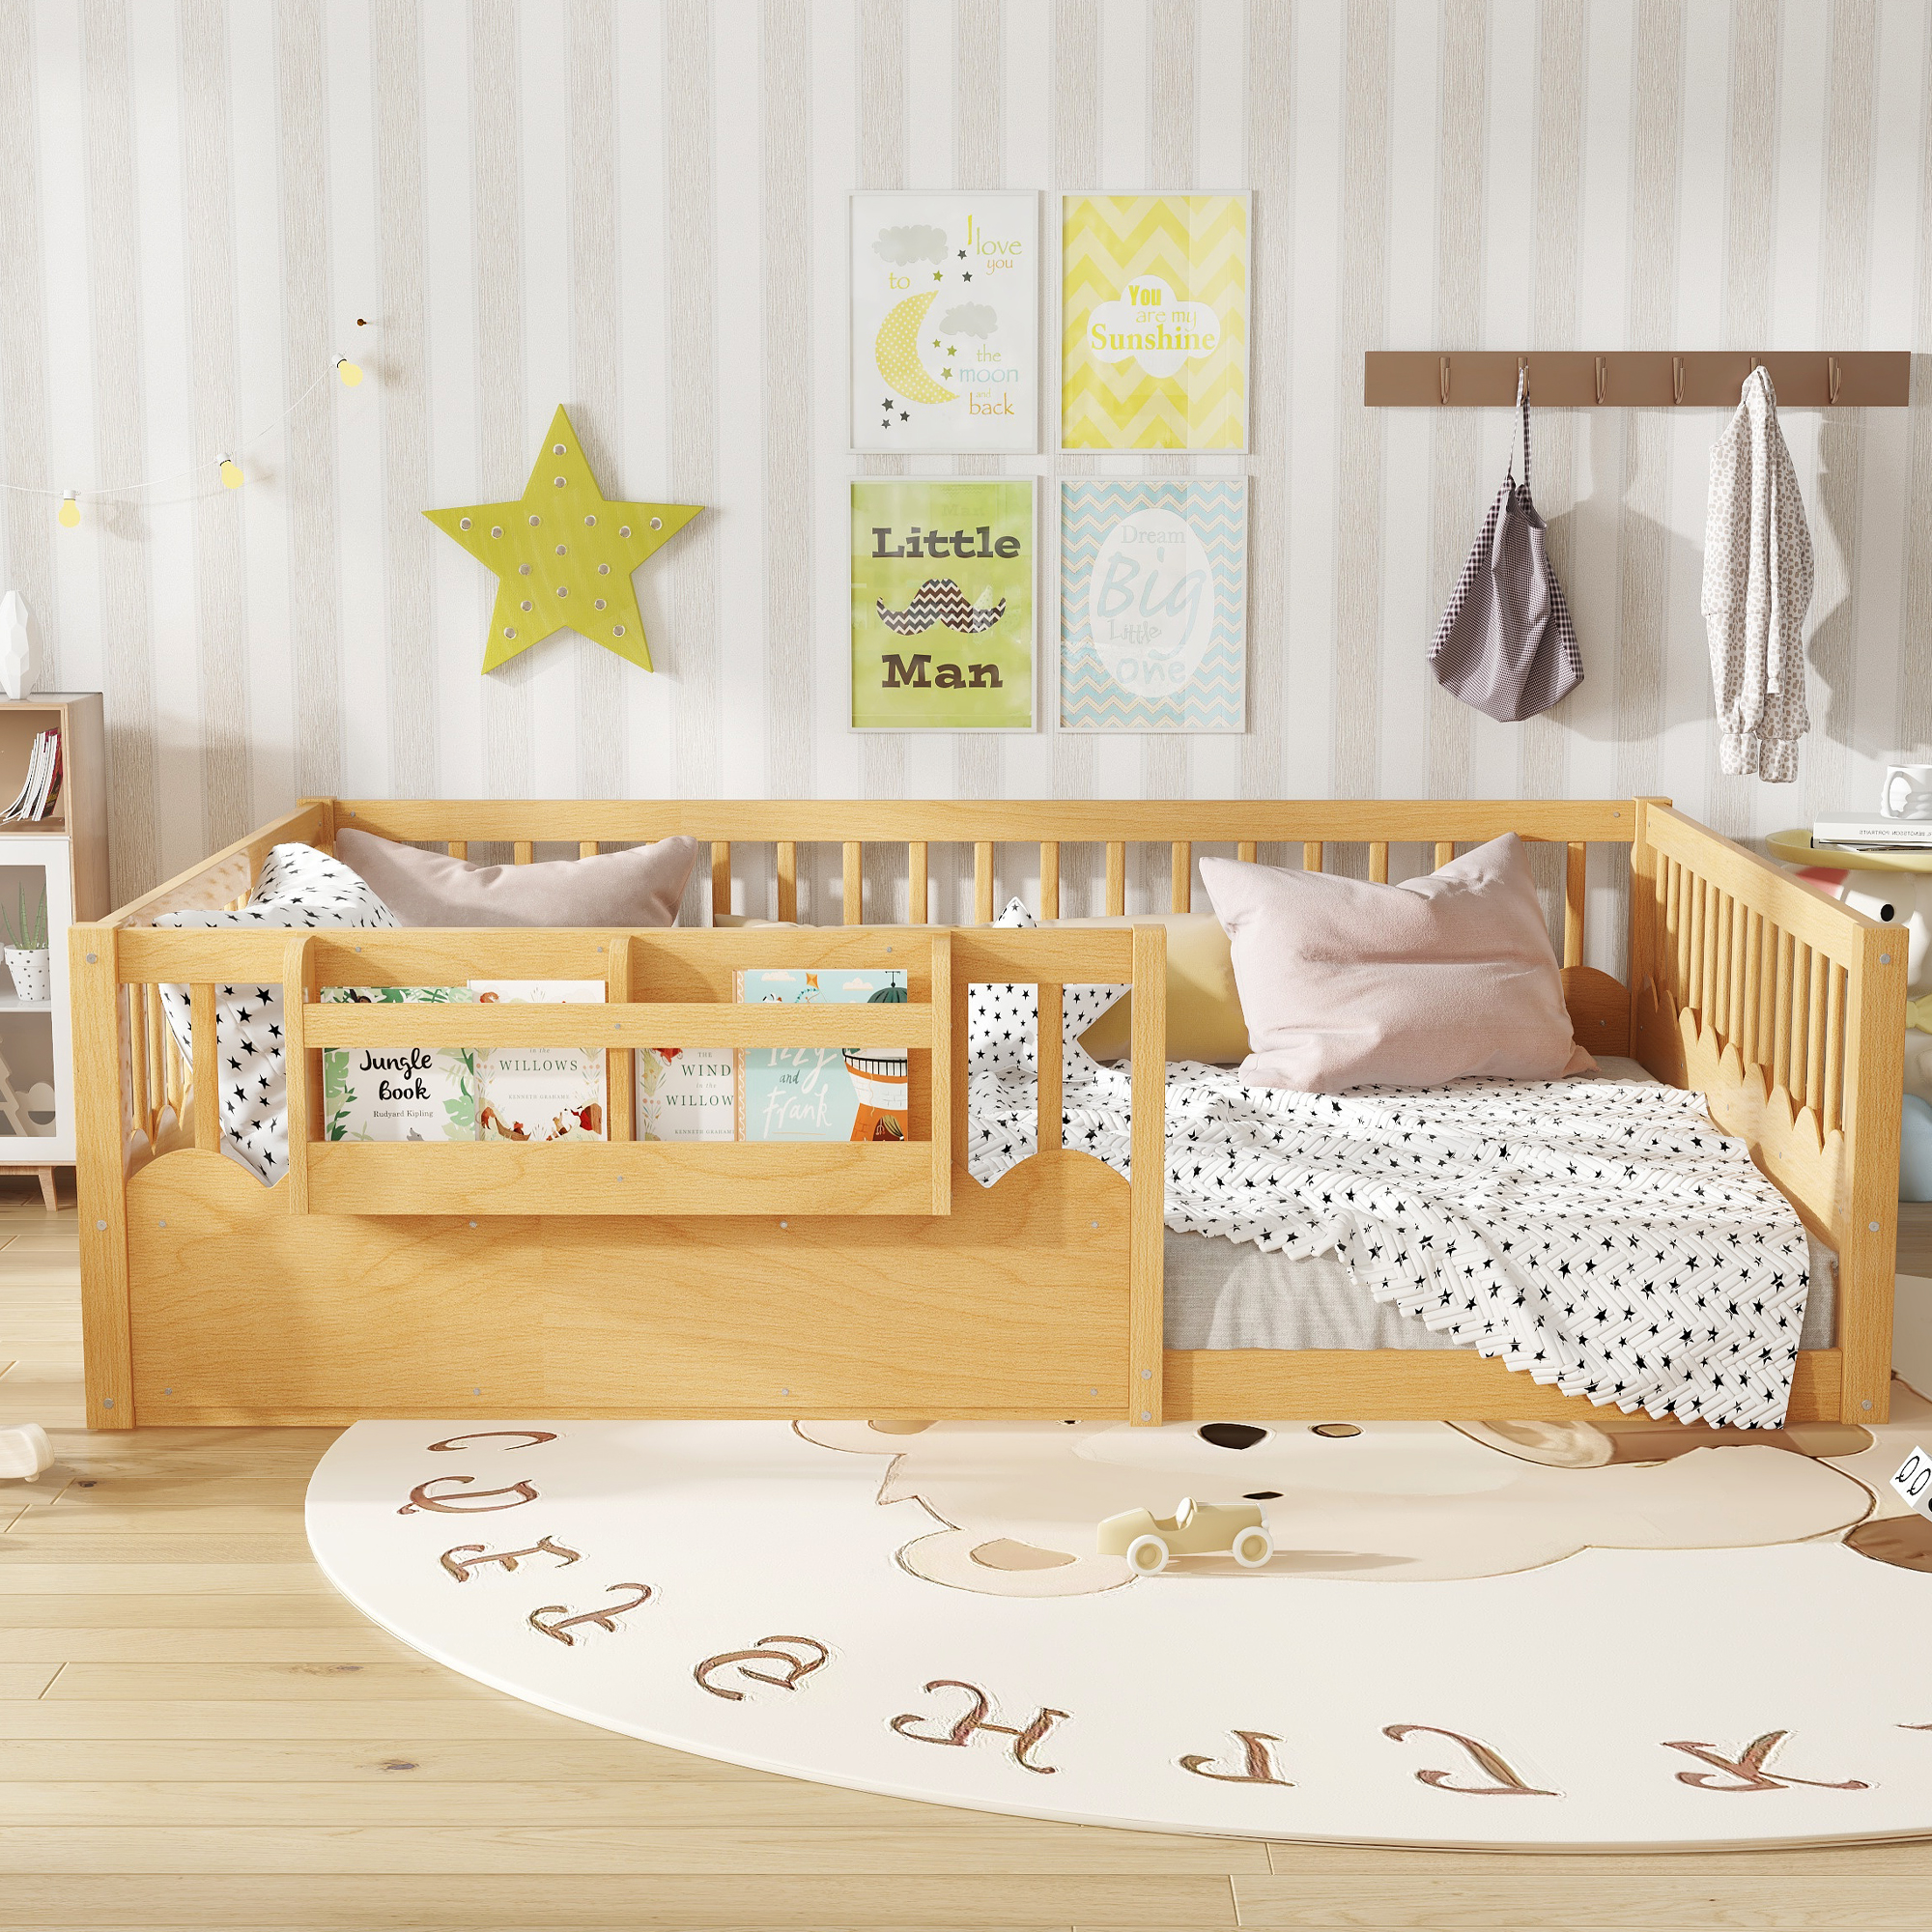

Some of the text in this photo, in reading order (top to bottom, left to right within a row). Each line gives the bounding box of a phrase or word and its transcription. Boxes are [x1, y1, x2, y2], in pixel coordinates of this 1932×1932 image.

[967, 214, 1023, 255] I love
[986, 259, 1013, 275] you
[889, 272, 911, 290] to
[1128, 285, 1162, 306] You
[1136, 310, 1197, 330] are my
[1091, 324, 1216, 351] Sunshine
[977, 344, 1002, 362] the
[959, 368, 1019, 383] moon
[969, 392, 1015, 415] back
[976, 388, 991, 399] and
[872, 526, 1021, 558] Little
[1121, 525, 1186, 544] Dream
[1097, 546, 1207, 660] Big
[1107, 619, 1162, 644] Little
[882, 653, 1004, 690] Man
[359, 1047, 433, 1080] Jungle
[499, 1060, 578, 1071] WILLOWS
[681, 1064, 731, 1077] WIND
[780, 1069, 801, 1084] and
[379, 1077, 431, 1100] Book
[373, 1109, 434, 1119] Rudyard Kipling
[762, 1083, 833, 1140] Frank
